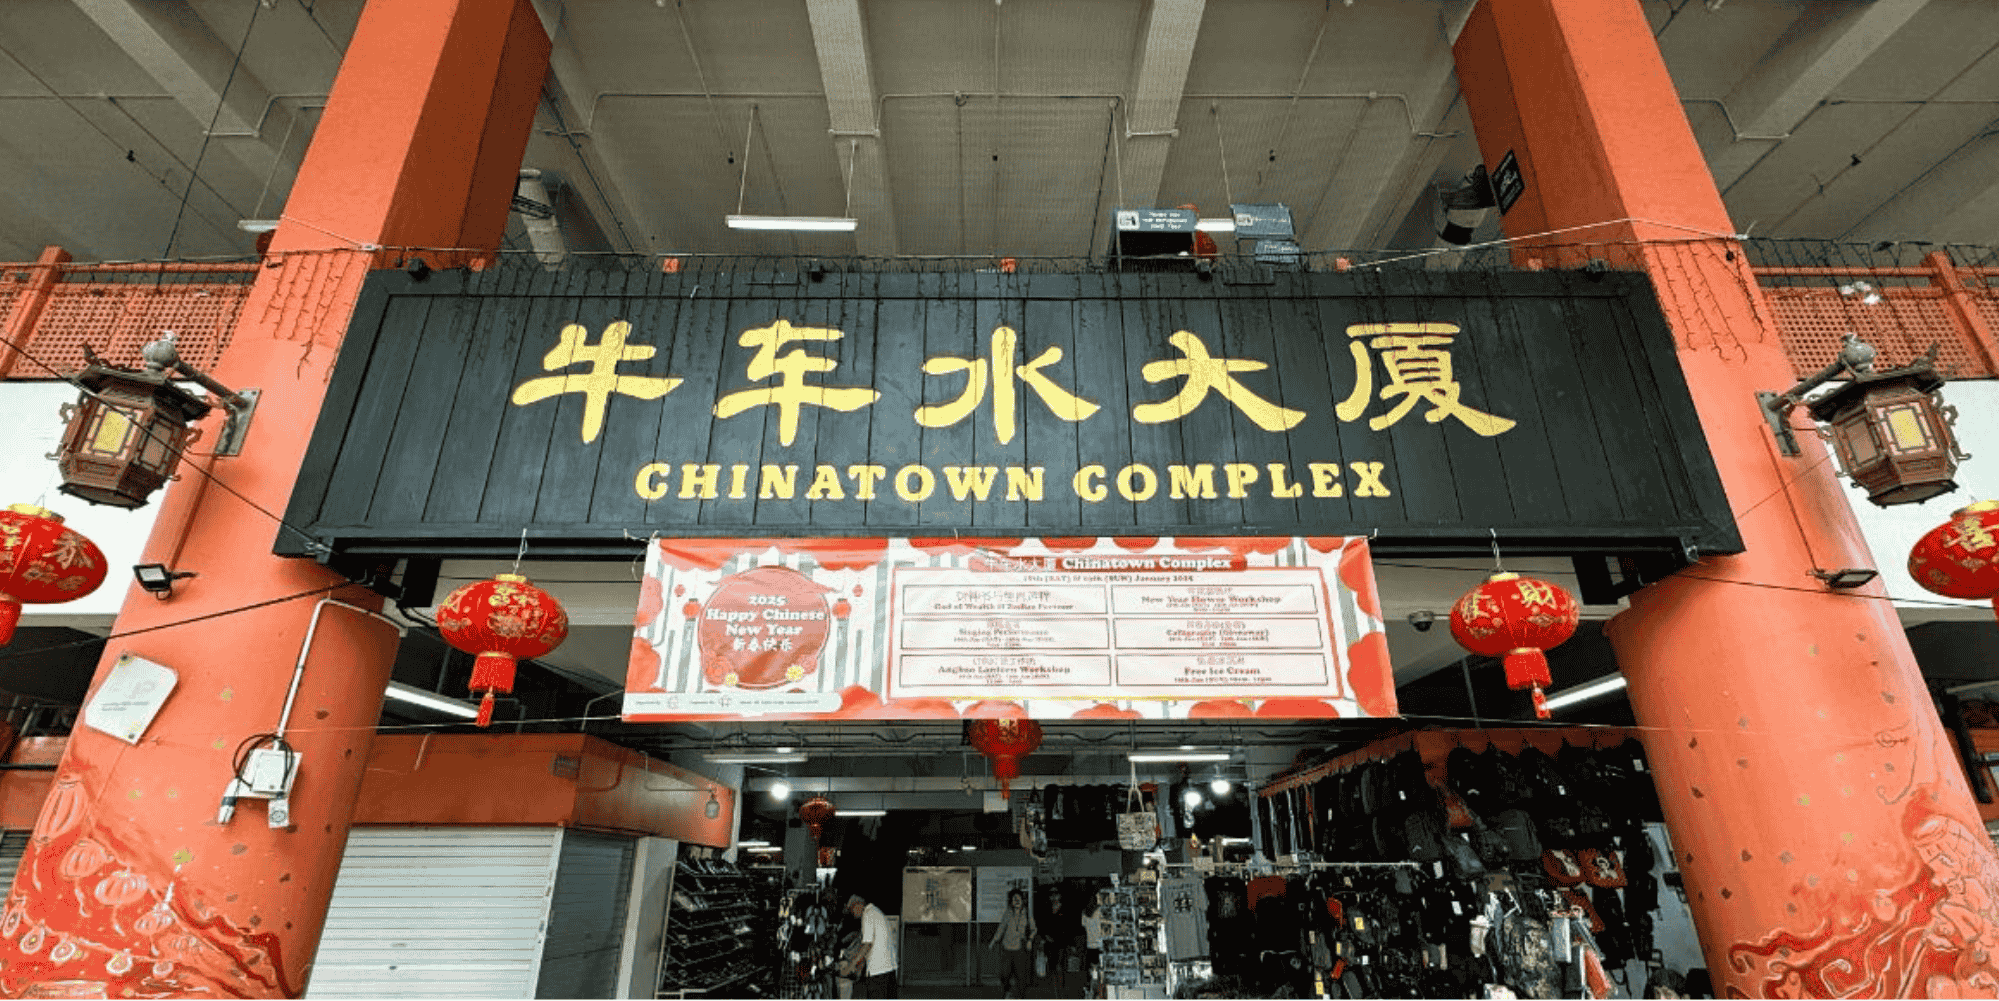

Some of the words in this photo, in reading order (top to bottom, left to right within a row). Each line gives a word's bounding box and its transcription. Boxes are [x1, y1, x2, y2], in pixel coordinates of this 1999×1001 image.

[512, 319, 1517, 446] 牛车水大厦
[634, 462, 1045, 501] CHINATOWN
[1073, 461, 1391, 501] COMPLEX
[1061, 556, 1156, 570] Chinatown
[1159, 557, 1231, 572] Complex
[1135, 574, 1171, 583] January
[748, 595, 787, 606] 2025
[1229, 596, 1282, 604] Workshop
[706, 608, 759, 622] Happy
[762, 608, 826, 621] Chinese
[725, 624, 762, 636] New
[766, 624, 803, 636] Year
[1019, 666, 1071, 674] Workshop
[1184, 667, 1206, 675] Free
[1210, 667, 1225, 675] Ice
[1226, 667, 1260, 675] Cream
